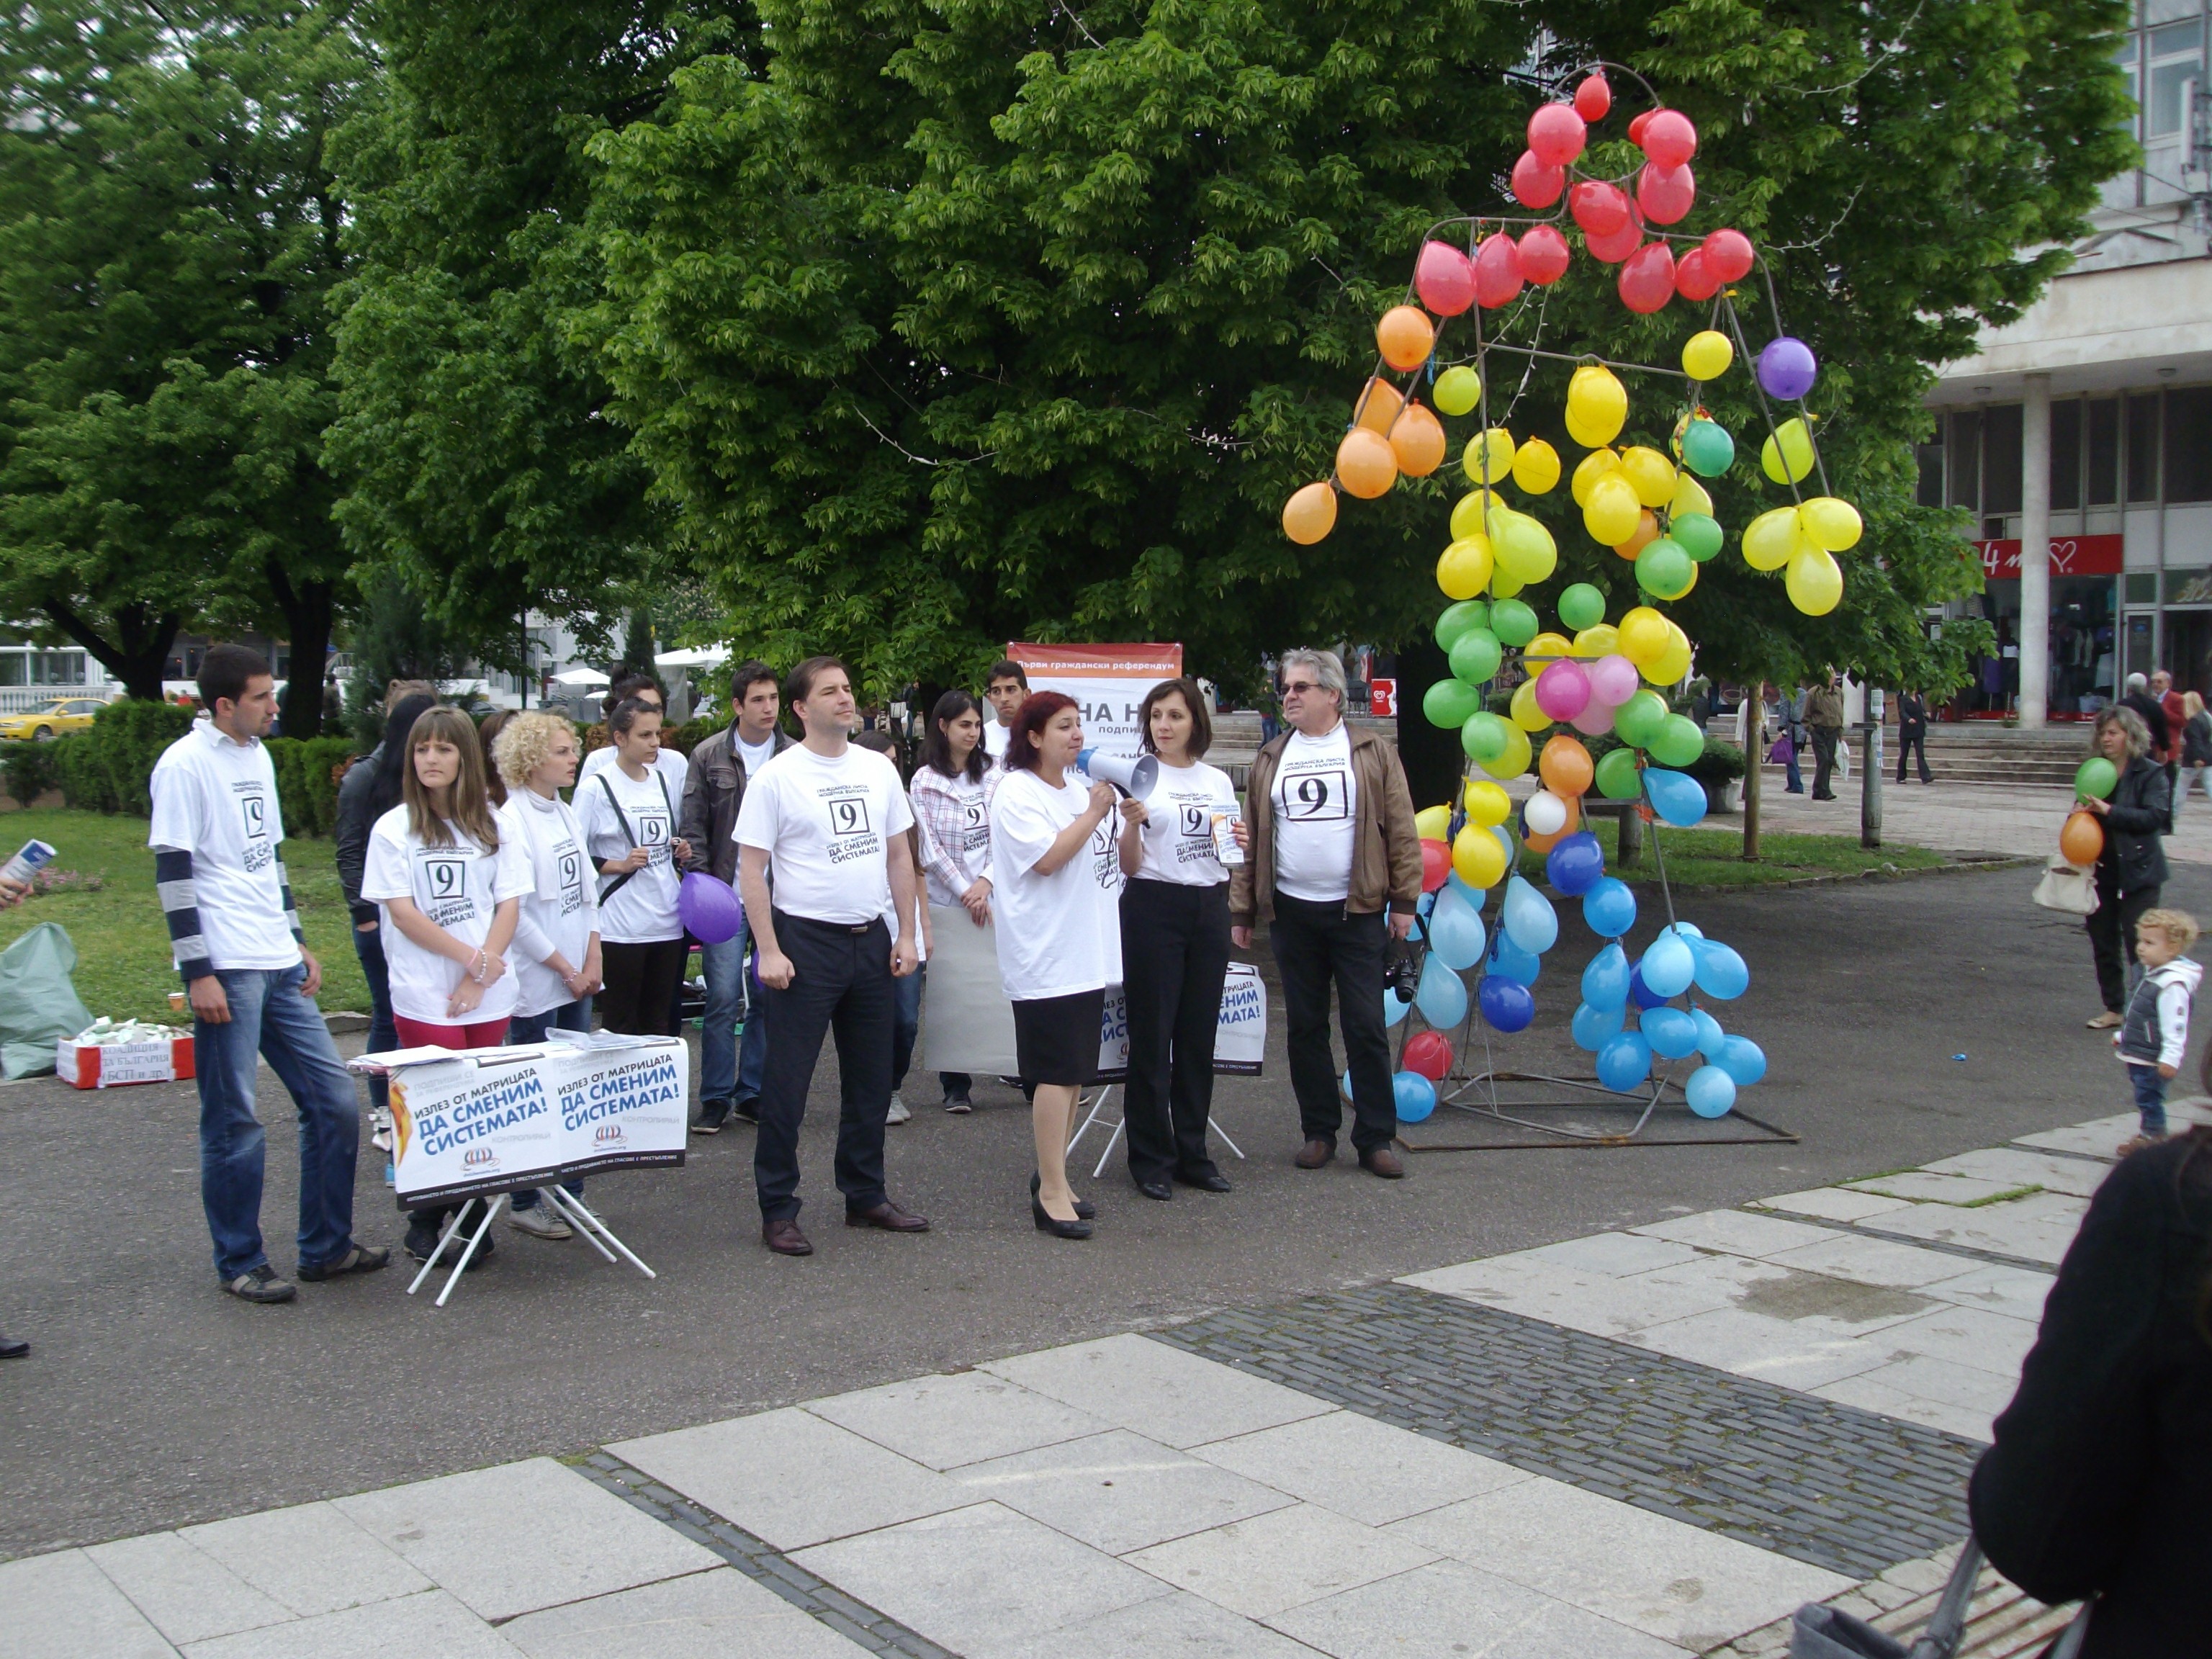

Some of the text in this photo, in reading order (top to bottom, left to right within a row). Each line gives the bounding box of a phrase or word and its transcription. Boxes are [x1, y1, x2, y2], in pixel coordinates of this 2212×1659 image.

[1983, 541, 2000, 575] 4
[1112, 662, 1174, 670] референдум
[1298, 778, 1328, 816] 9
[250, 801, 264, 833] 9
[840, 804, 857, 830] 9
[967, 807, 980, 826] 9
[1187, 807, 1202, 832] 9
[648, 820, 660, 843] 9
[829, 837, 878, 858] ДА СМЕНИМ
[436, 864, 454, 895] 9
[565, 858, 575, 885] 9
[440, 902, 474, 917] МЕНИМ
[1223, 981, 1254, 994] ТРИЦАТА
[1218, 1005, 1260, 1024] МАТА!
[557, 1053, 673, 1095] ИЗЛЕЗ ОТ МАТРИЦАТА
[414, 1067, 537, 1119] ИЗЛЕЗ ОТ МАТРИЦАТА
[561, 1064, 677, 1115] ДА СМЕНИМ
[418, 1078, 543, 1140] ДА СМЕНИМ
[565, 1083, 680, 1131] СИСТЕМАТА!
[424, 1097, 548, 1156] СИСТЕМАТА!
